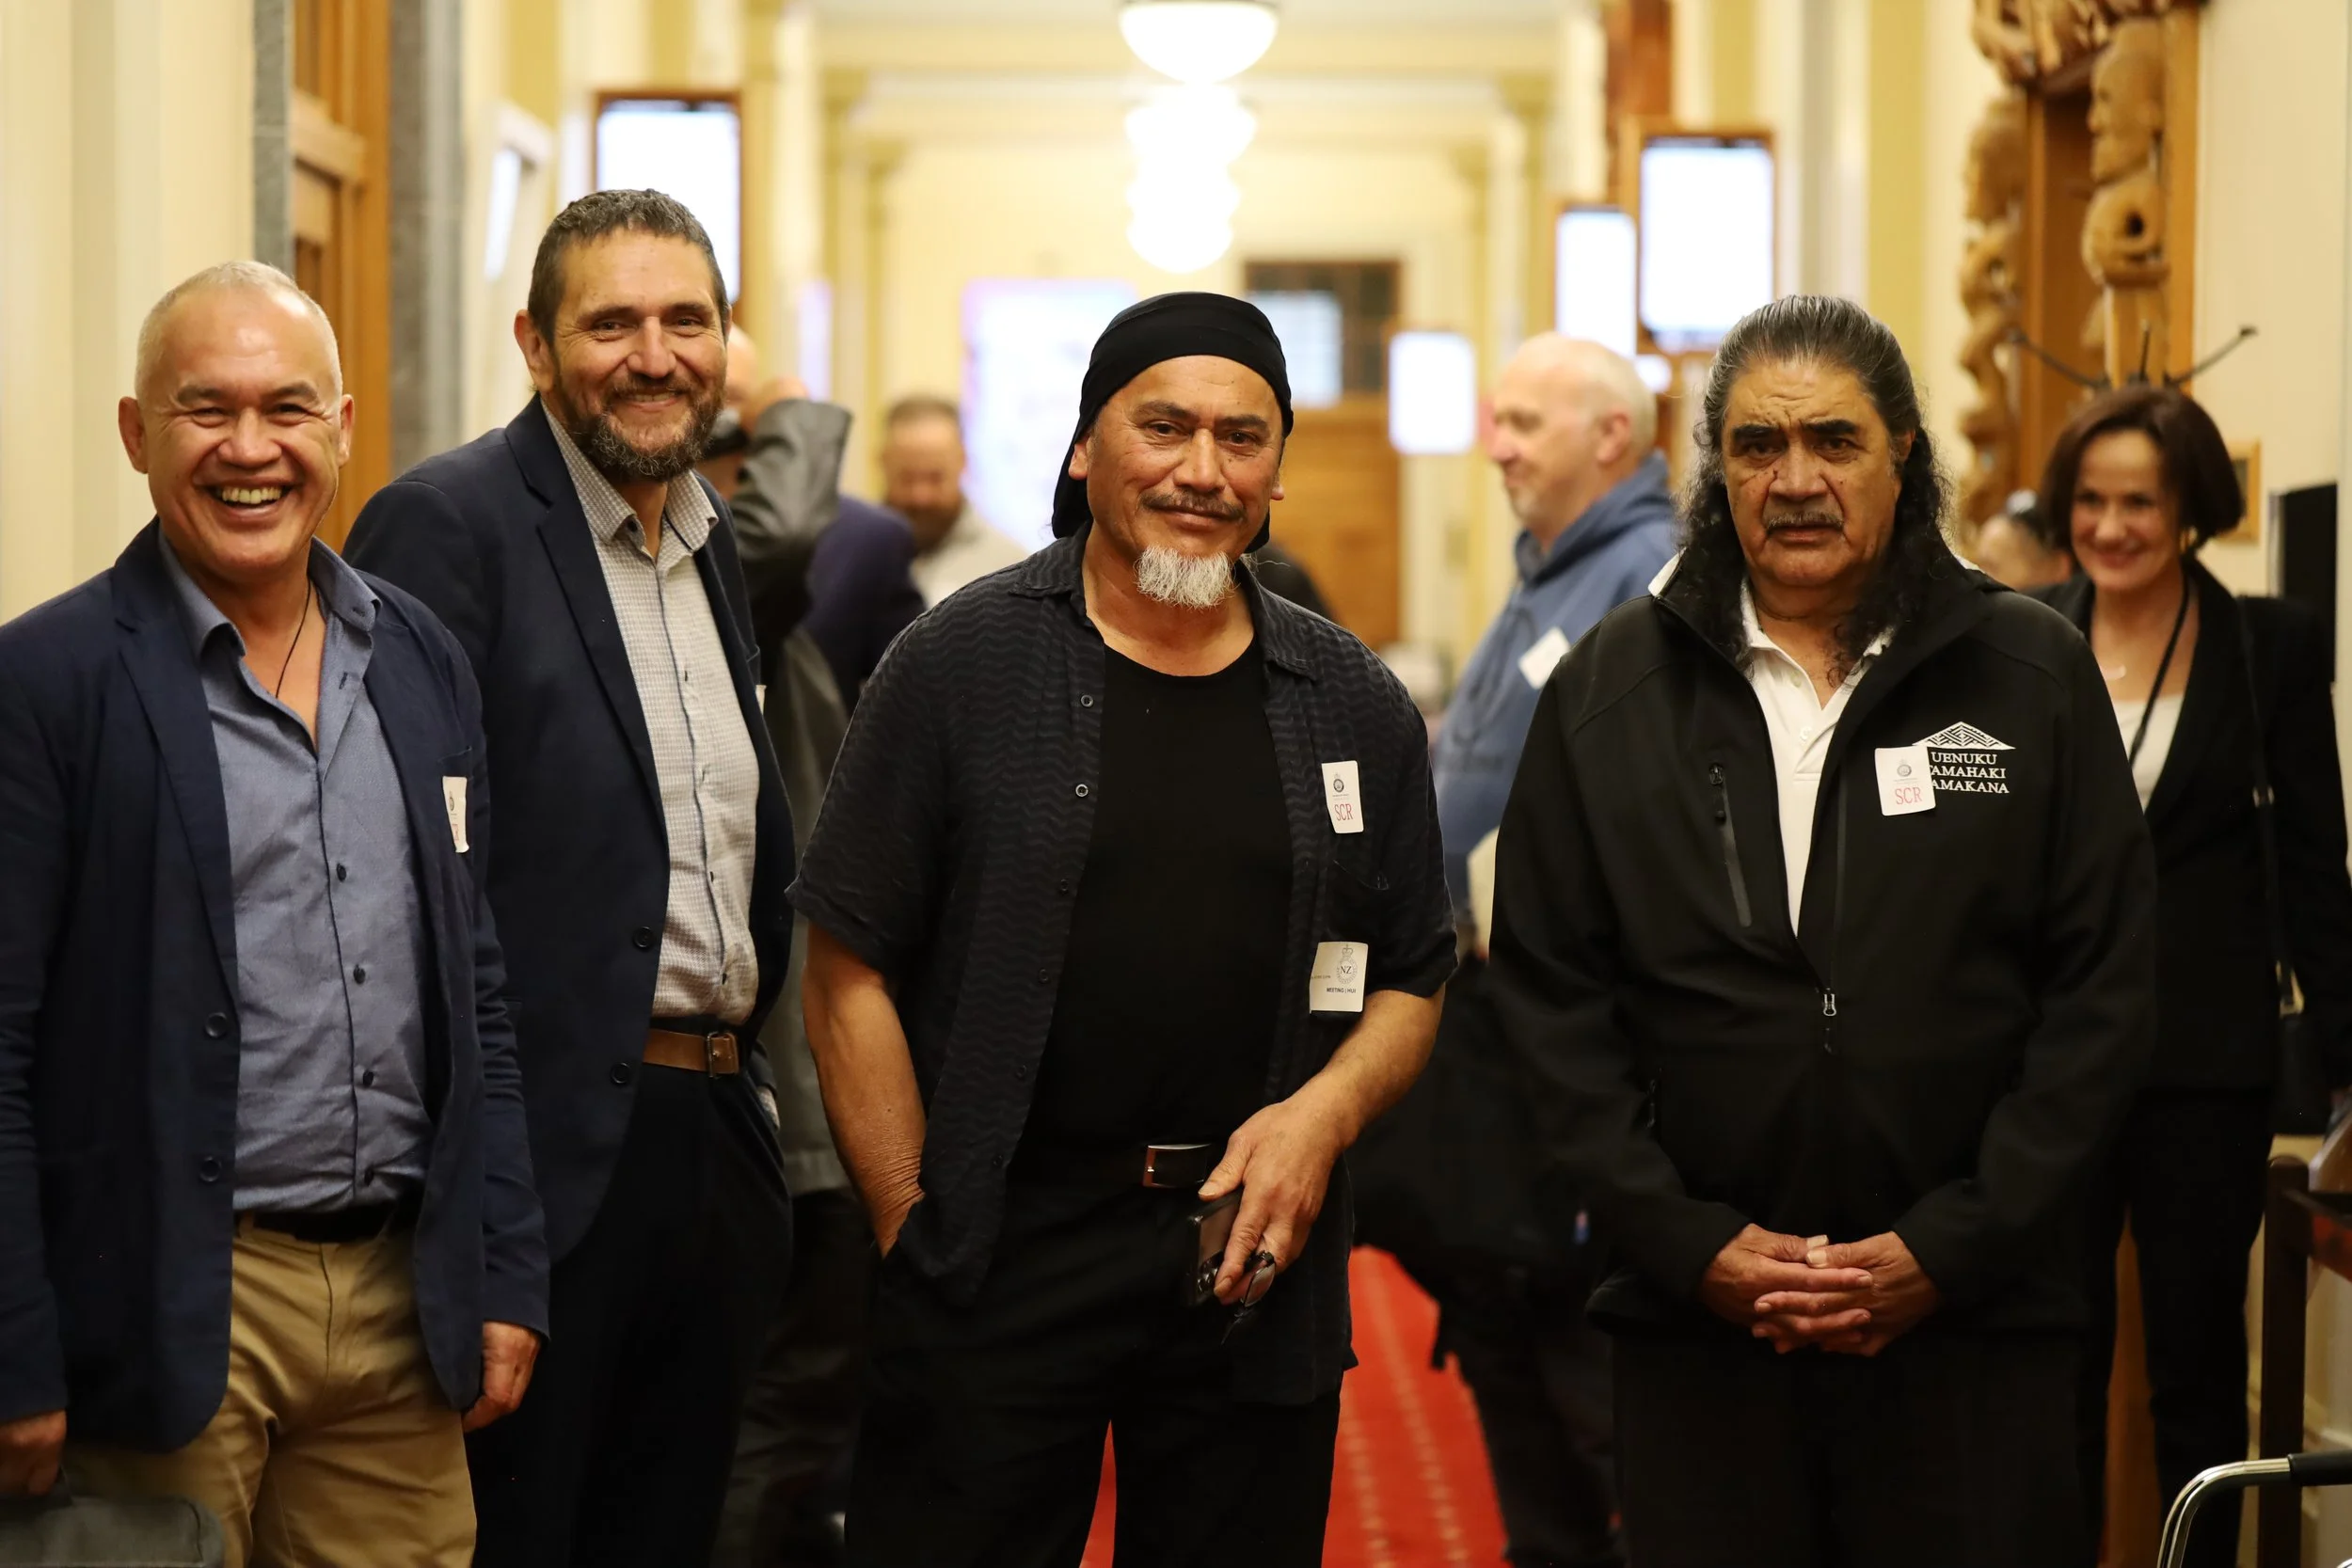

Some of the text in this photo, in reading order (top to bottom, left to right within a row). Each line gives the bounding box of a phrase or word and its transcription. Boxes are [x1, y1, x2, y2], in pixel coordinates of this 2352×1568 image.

[1931, 752, 1997, 765] UENUKU
[1931, 779, 2010, 794] AMAKANA
[1895, 786, 1923, 805] SCR
[1334, 803, 1354, 821] SCR
[1341, 965, 1352, 974] NZ
